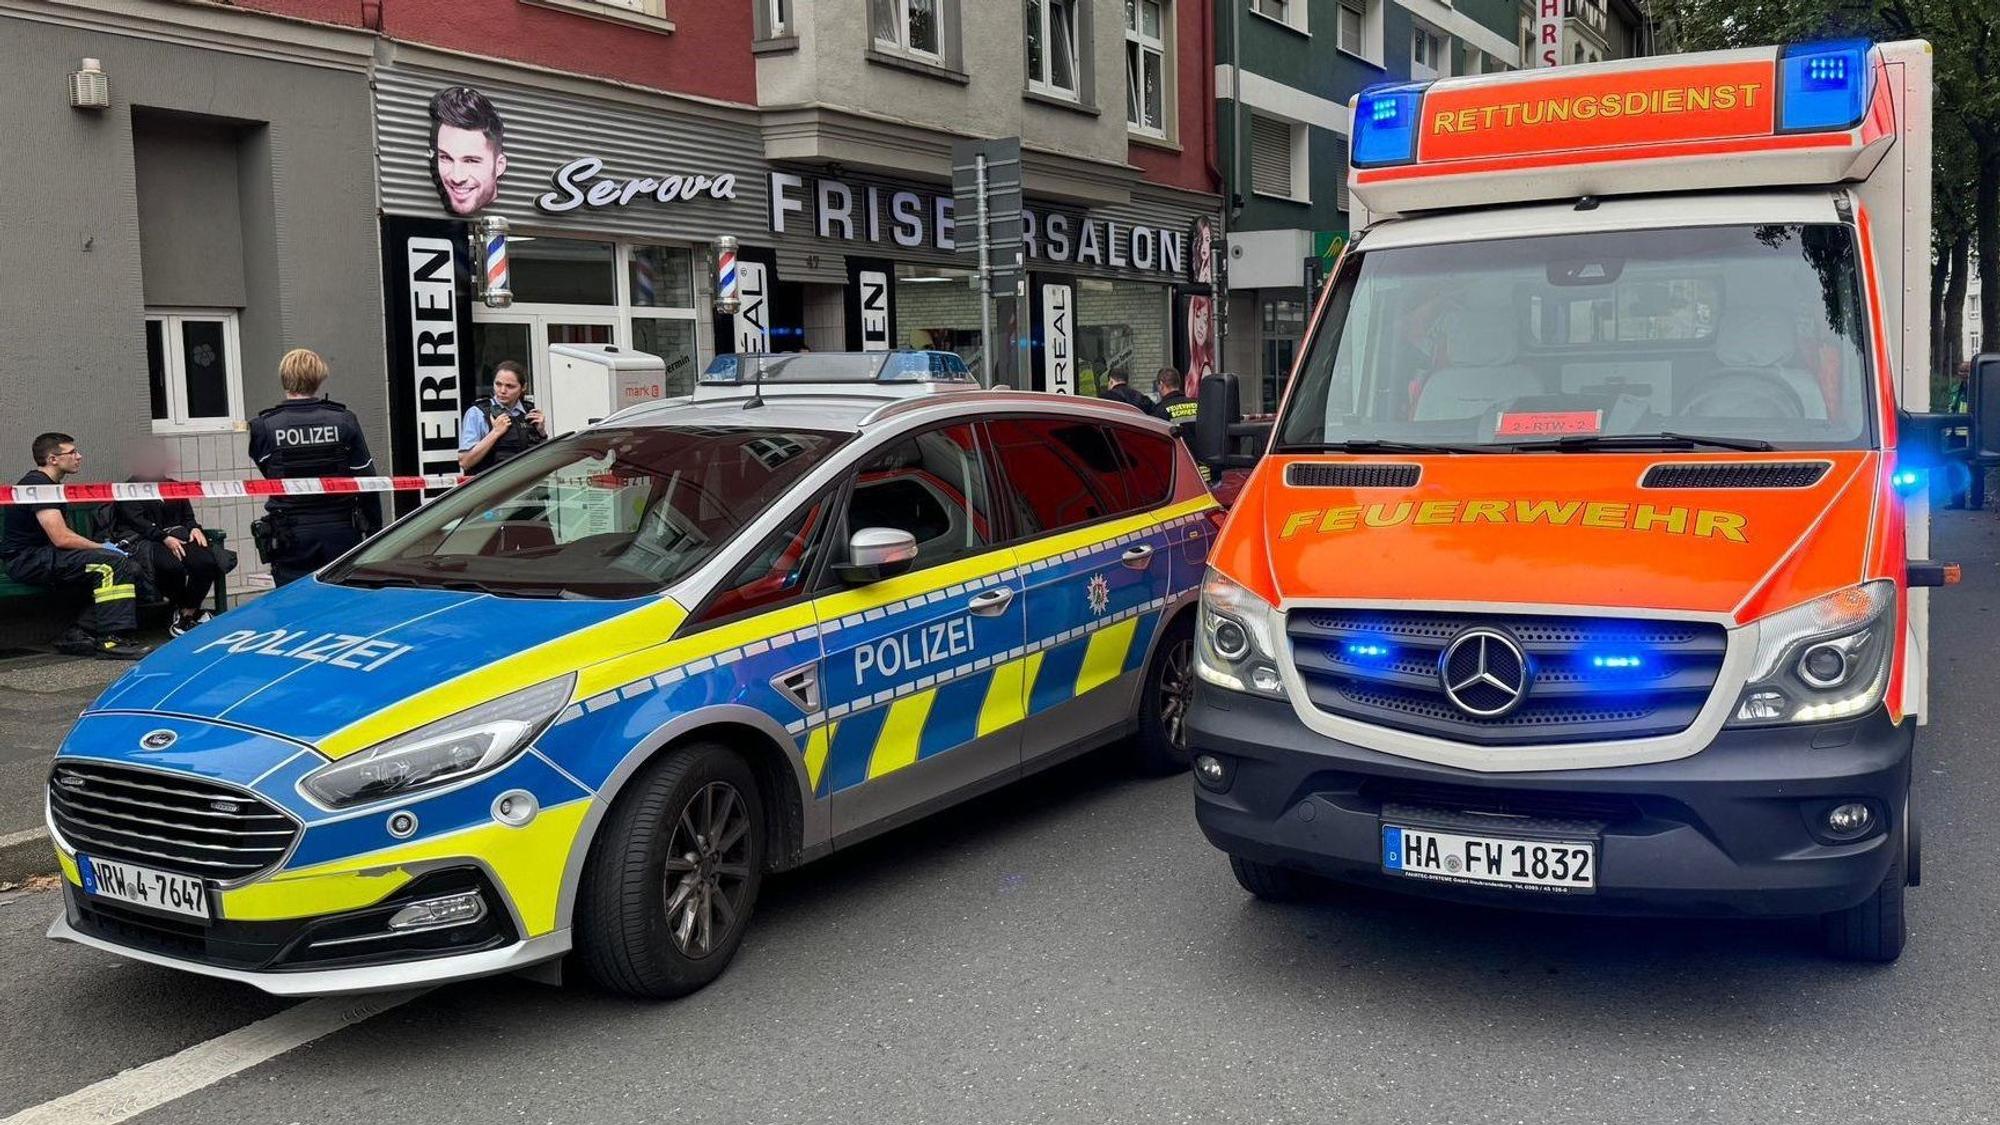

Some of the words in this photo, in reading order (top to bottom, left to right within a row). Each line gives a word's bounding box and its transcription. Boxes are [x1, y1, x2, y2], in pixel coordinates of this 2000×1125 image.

[1433, 83, 1761, 135] RETTUNGSDIENST
[539, 157, 736, 212] Serova
[771, 172, 1181, 272] FRISERSALON
[411, 248, 461, 499] HERREN
[667, 354, 690, 373] ermin
[275, 426, 339, 446] POLIZEI
[1279, 500, 1749, 543] FEUERWEHR
[192, 629, 413, 672] POLIZEI
[855, 615, 975, 686] POLIZEI
[1405, 834, 1440, 869] HA
[1465, 841, 1503, 875] FW
[1511, 846, 1590, 881] 1832
[136, 871, 203, 912] 4-7647
